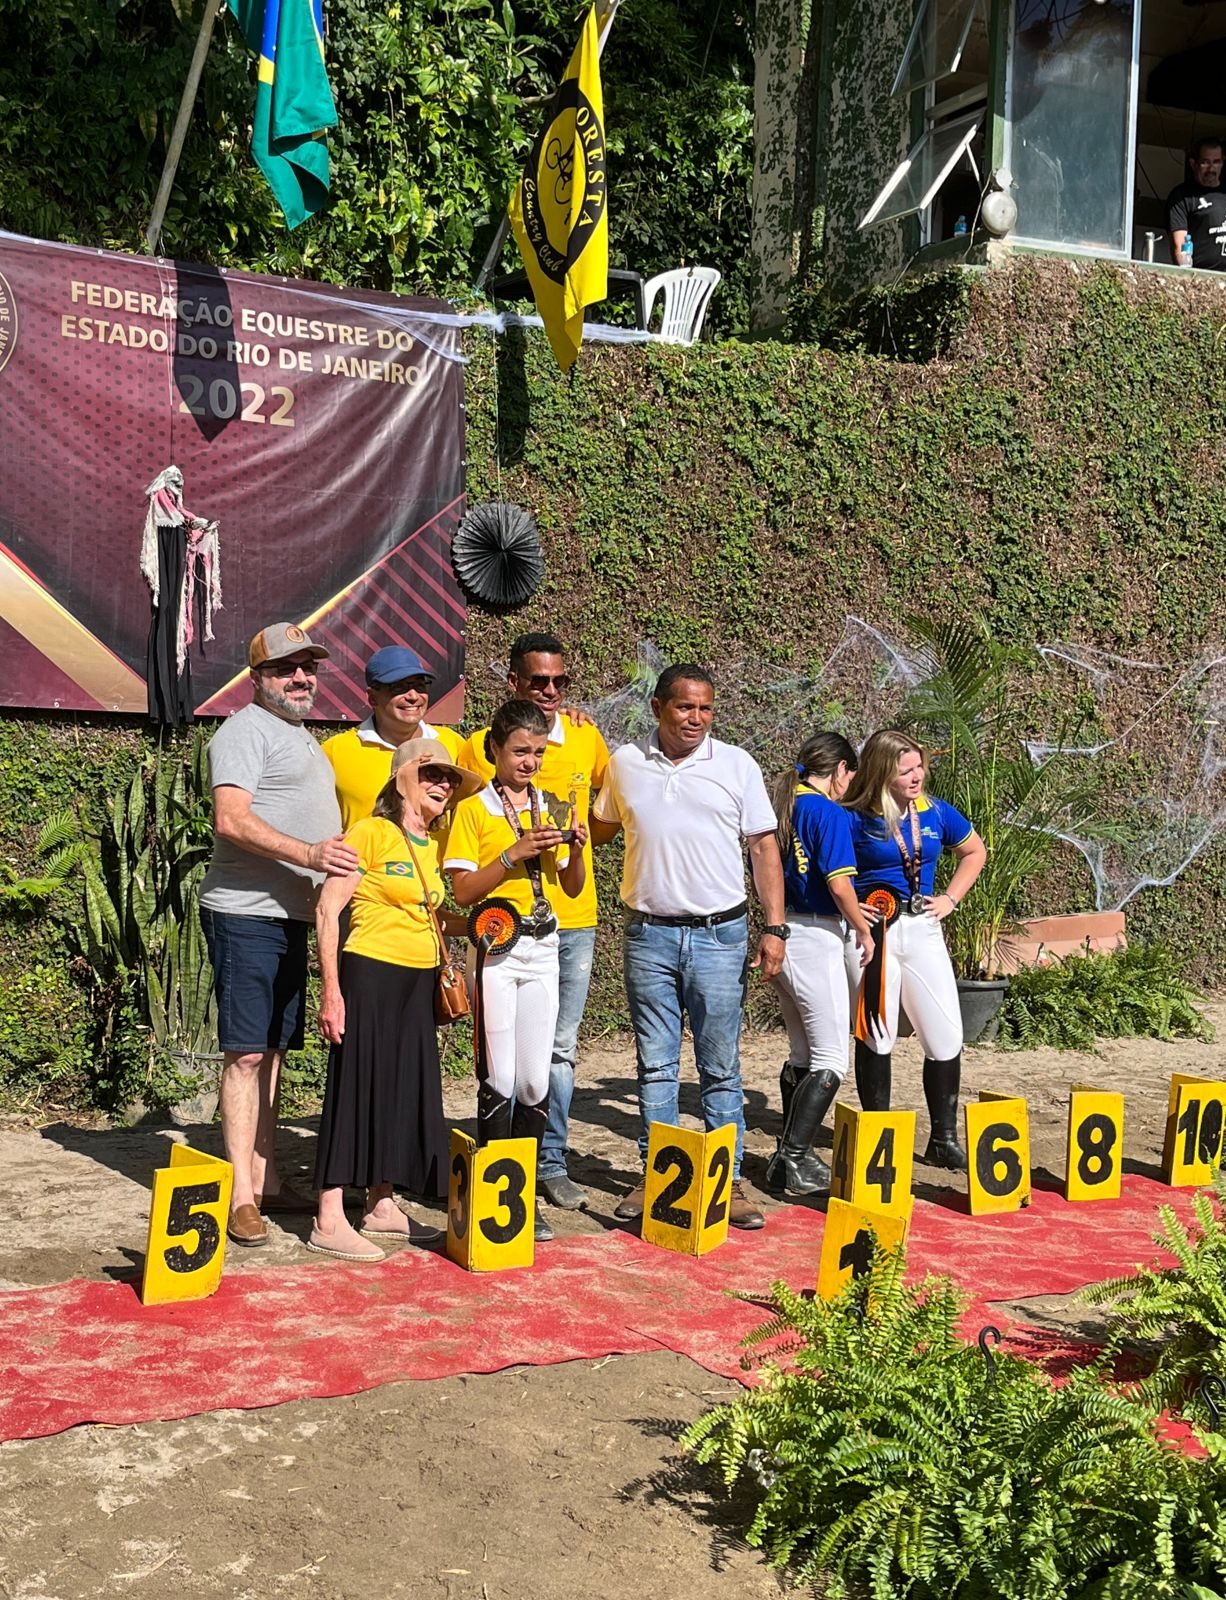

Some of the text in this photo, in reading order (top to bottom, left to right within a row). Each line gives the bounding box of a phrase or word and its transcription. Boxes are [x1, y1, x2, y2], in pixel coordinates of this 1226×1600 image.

[524, 177, 565, 272] Country Club
[61, 314, 422, 387] ESTADO DO RIO DE JANEIRO
[70, 280, 414, 352] FEDERAÇÃO EQUESTRE DO
[179, 374, 296, 428] 2022
[866, 1127, 897, 1204] 4
[976, 1122, 1023, 1197] 6
[1077, 1112, 1117, 1186] 8
[1177, 1099, 1224, 1166] 10
[451, 1152, 468, 1240] 3
[479, 1157, 527, 1244] 3
[649, 1145, 696, 1230] 2
[704, 1145, 730, 1231] 2
[163, 1179, 221, 1274] 5
